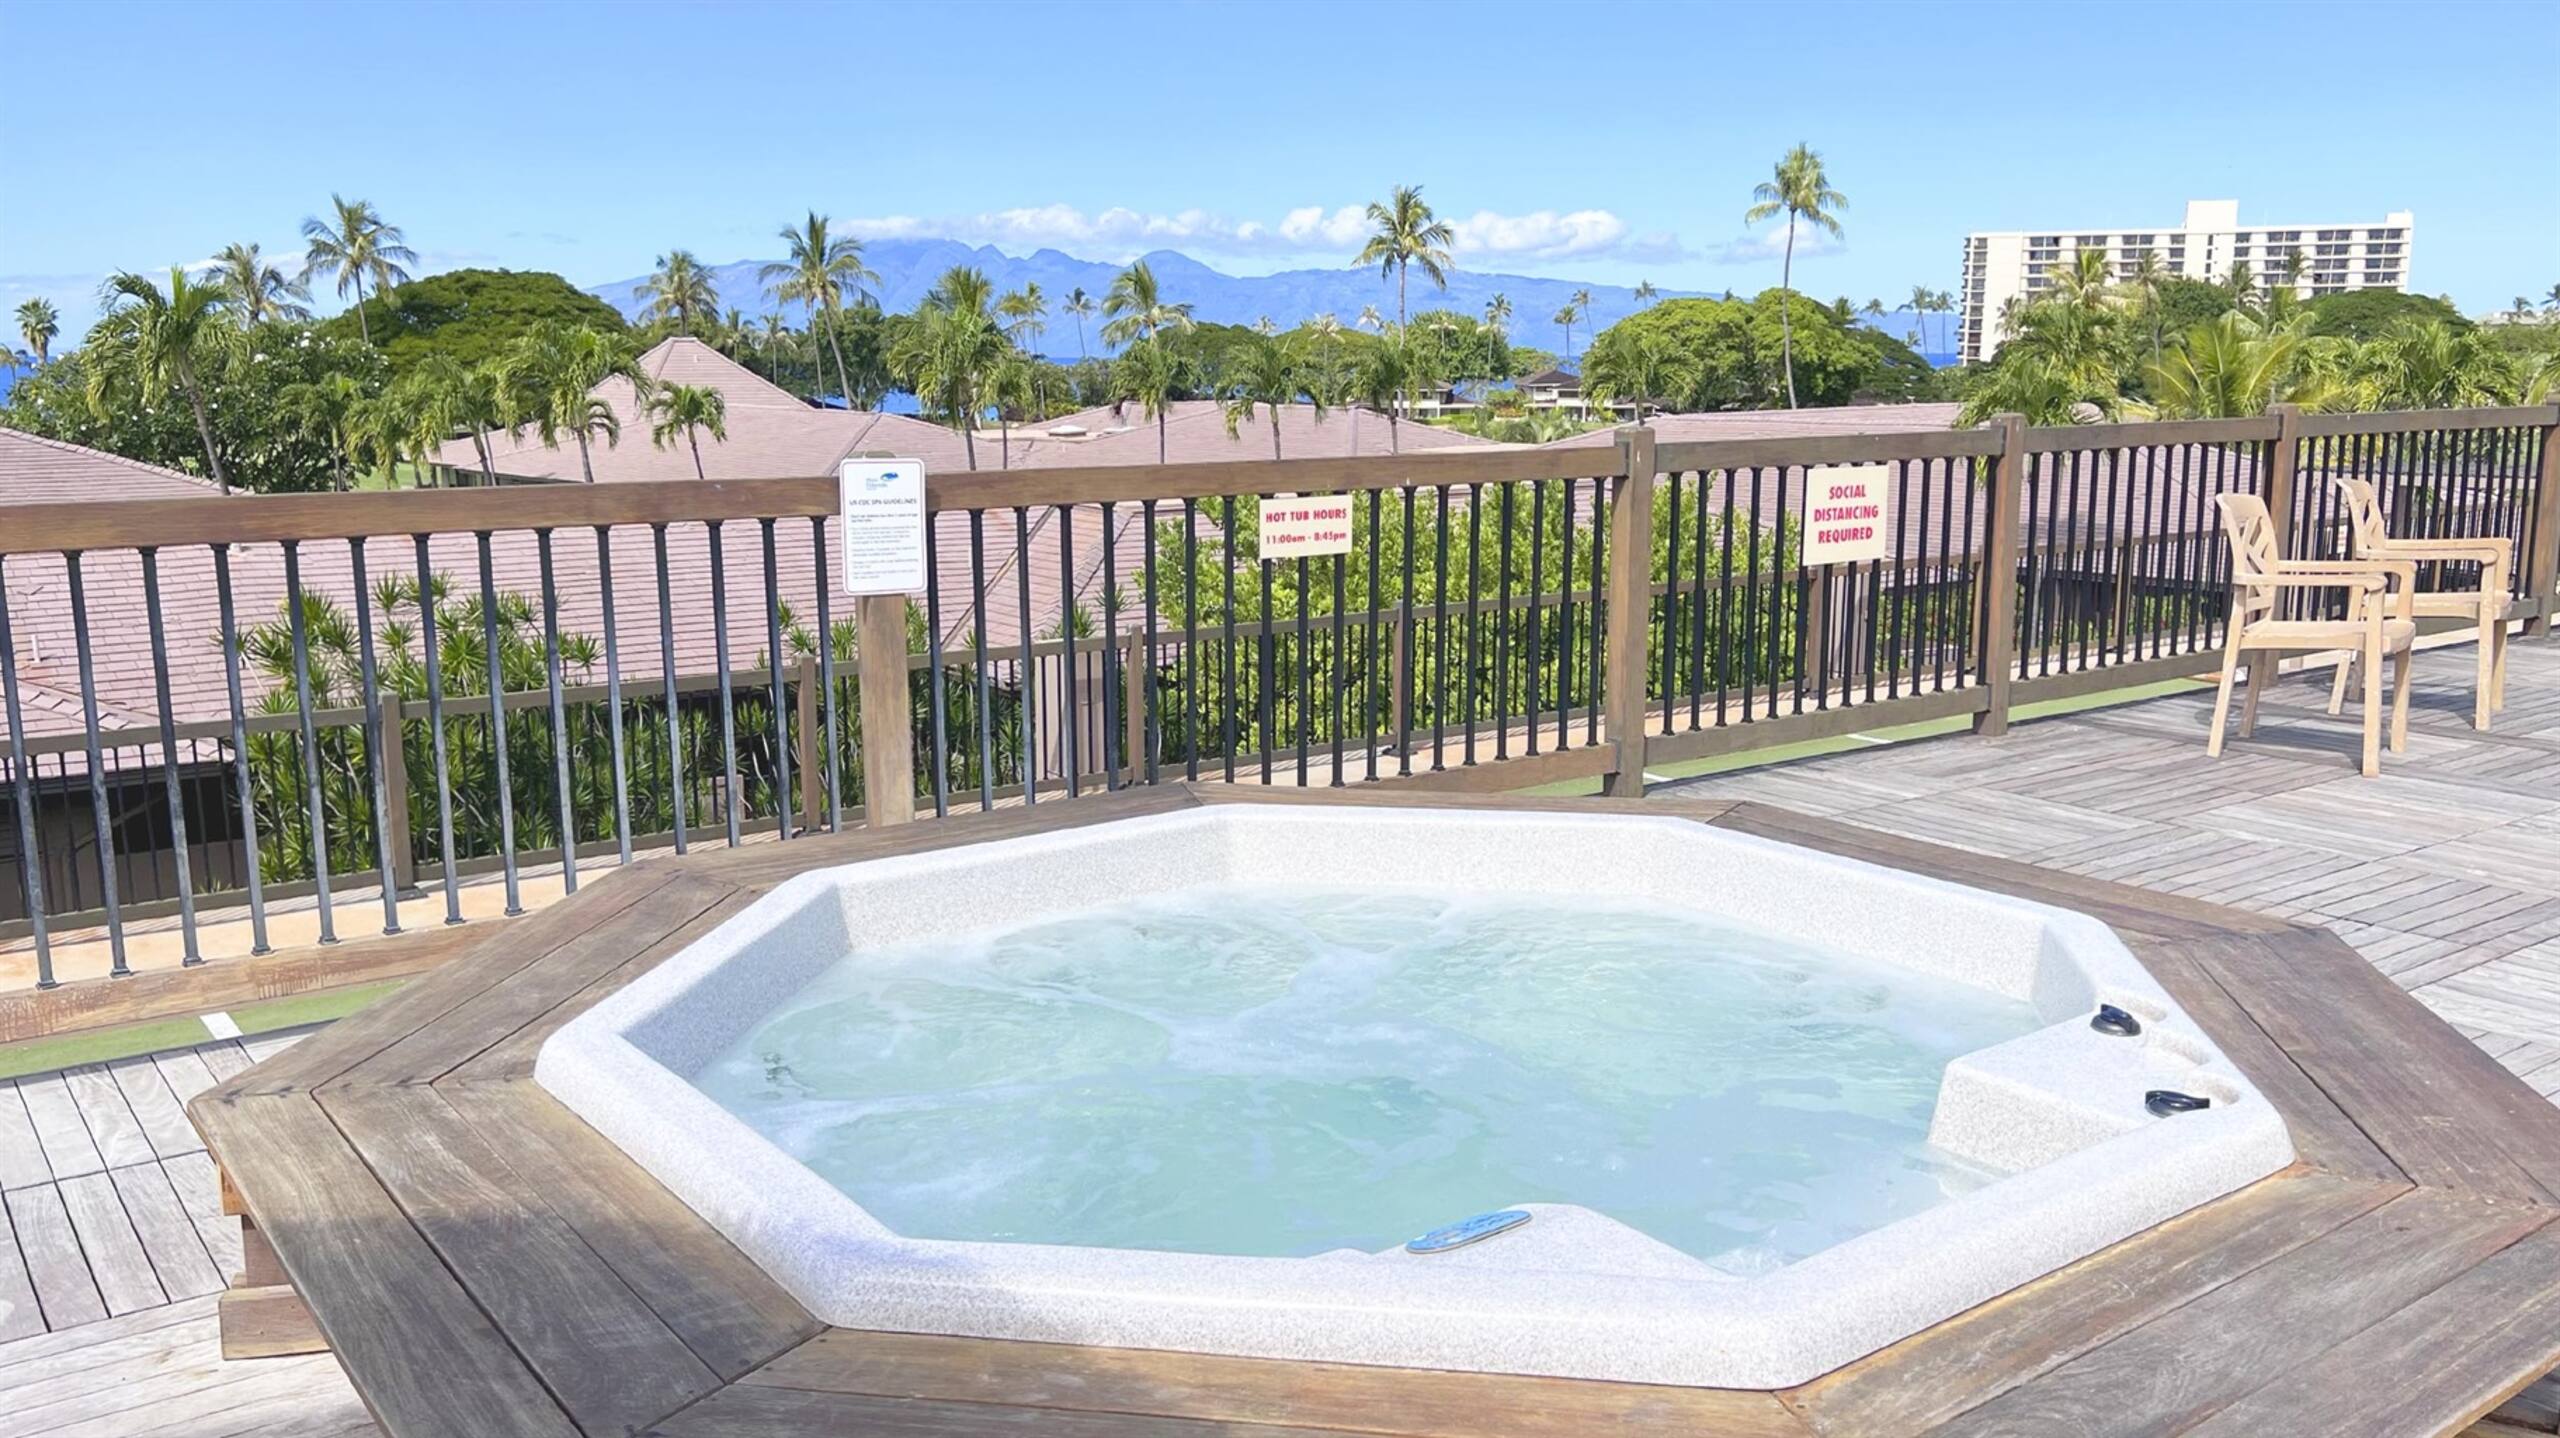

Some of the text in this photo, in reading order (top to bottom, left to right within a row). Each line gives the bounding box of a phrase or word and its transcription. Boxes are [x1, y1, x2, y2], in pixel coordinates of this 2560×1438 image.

[1829, 485, 1866, 500] SOCIAL
[883, 497, 917, 505] GUIDELINES
[1266, 508, 1347, 522] HOT TUB HOURS
[1814, 505, 1878, 522] DISTANCING
[1266, 534, 1305, 544] 11:00am
[1314, 532, 1346, 542] 8:45pm
[1818, 526, 1873, 544] REQUIRED
